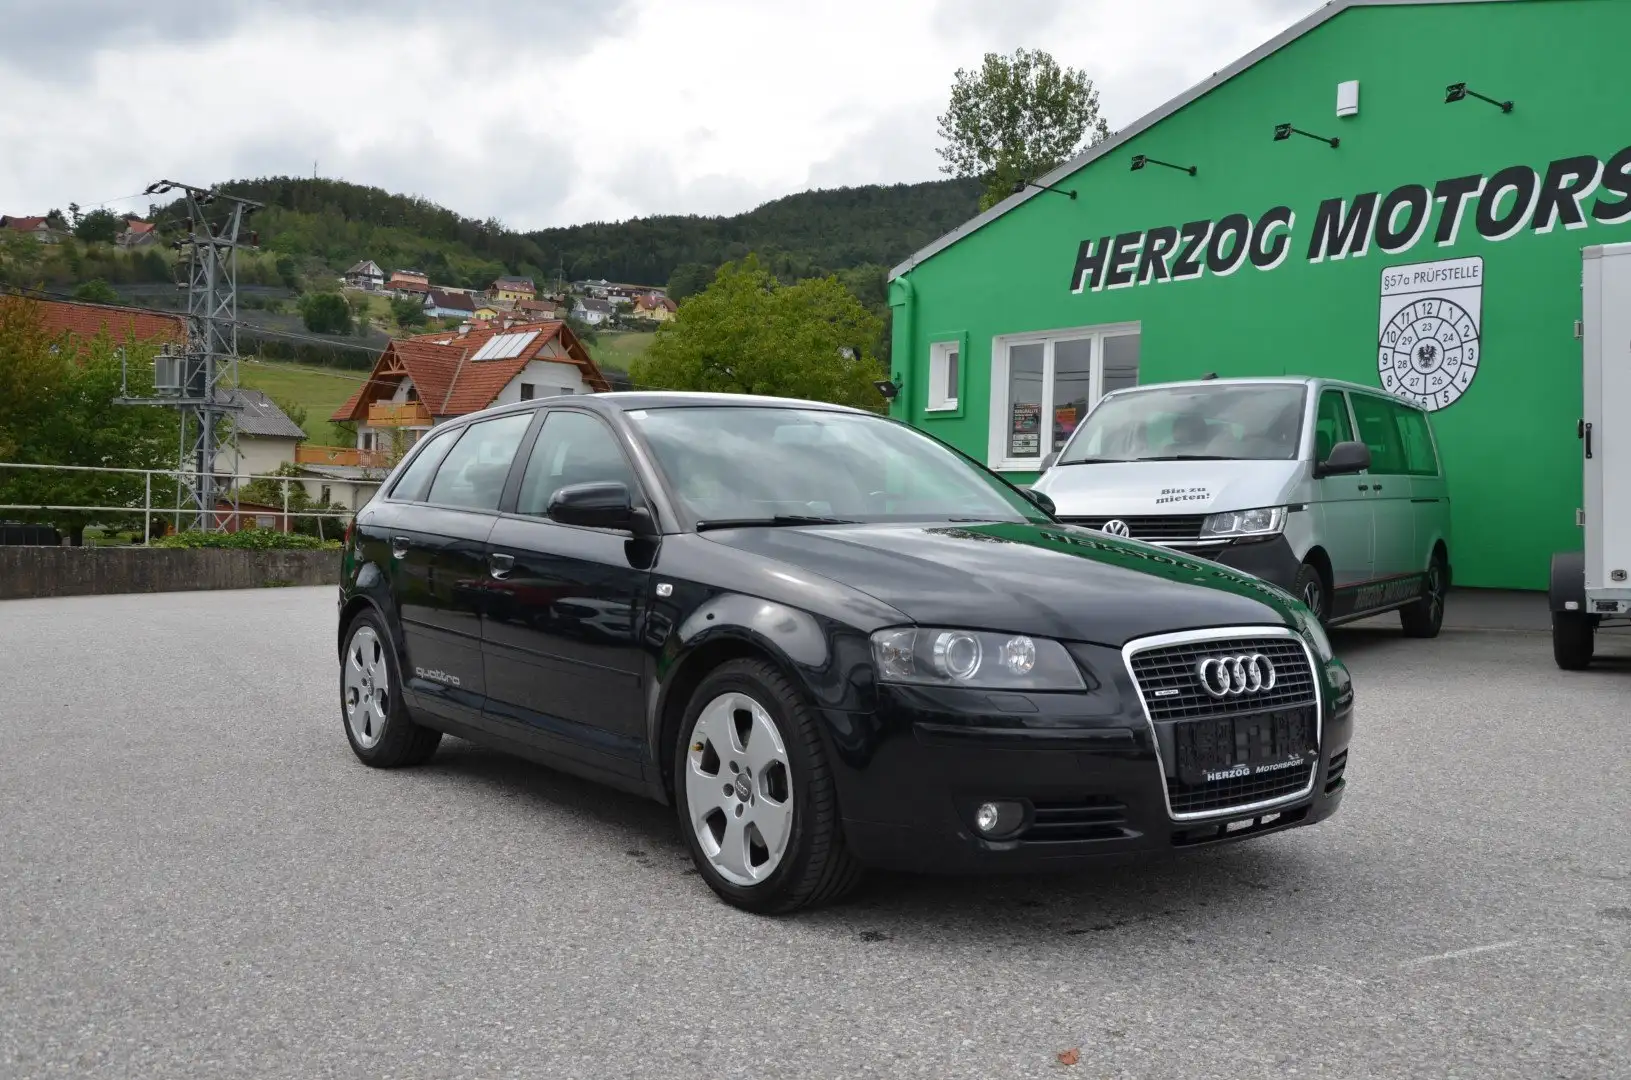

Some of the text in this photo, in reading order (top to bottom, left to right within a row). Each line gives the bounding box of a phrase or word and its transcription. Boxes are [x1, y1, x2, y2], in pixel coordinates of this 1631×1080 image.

[1069, 145, 1631, 294] HERZOG MOTORS
[1384, 265, 1479, 291] §57a PRÜFSTELLE
[1422, 302, 1433, 315] 12
[1448, 307, 1453, 320] 1
[1401, 312, 1410, 324] 11
[1422, 323, 1432, 332] 23
[1463, 325, 1470, 337] 2
[1386, 331, 1396, 343] 10
[1402, 336, 1412, 345] 29
[1443, 333, 1454, 343] 24
[1382, 352, 1388, 365] 9
[1468, 348, 1474, 360] 3
[1397, 360, 1407, 369] 28
[1447, 356, 1458, 366] 25
[1387, 375, 1392, 387] 8
[1410, 377, 1420, 386] 27
[1432, 376, 1443, 386] 26
[1461, 372, 1467, 384] 4
[1443, 391, 1449, 403] 5
[1156, 493, 1210, 504] mieten!
[415, 666, 461, 686] quattro
[1207, 759, 1304, 781] HERZOG MOTORSPORT
